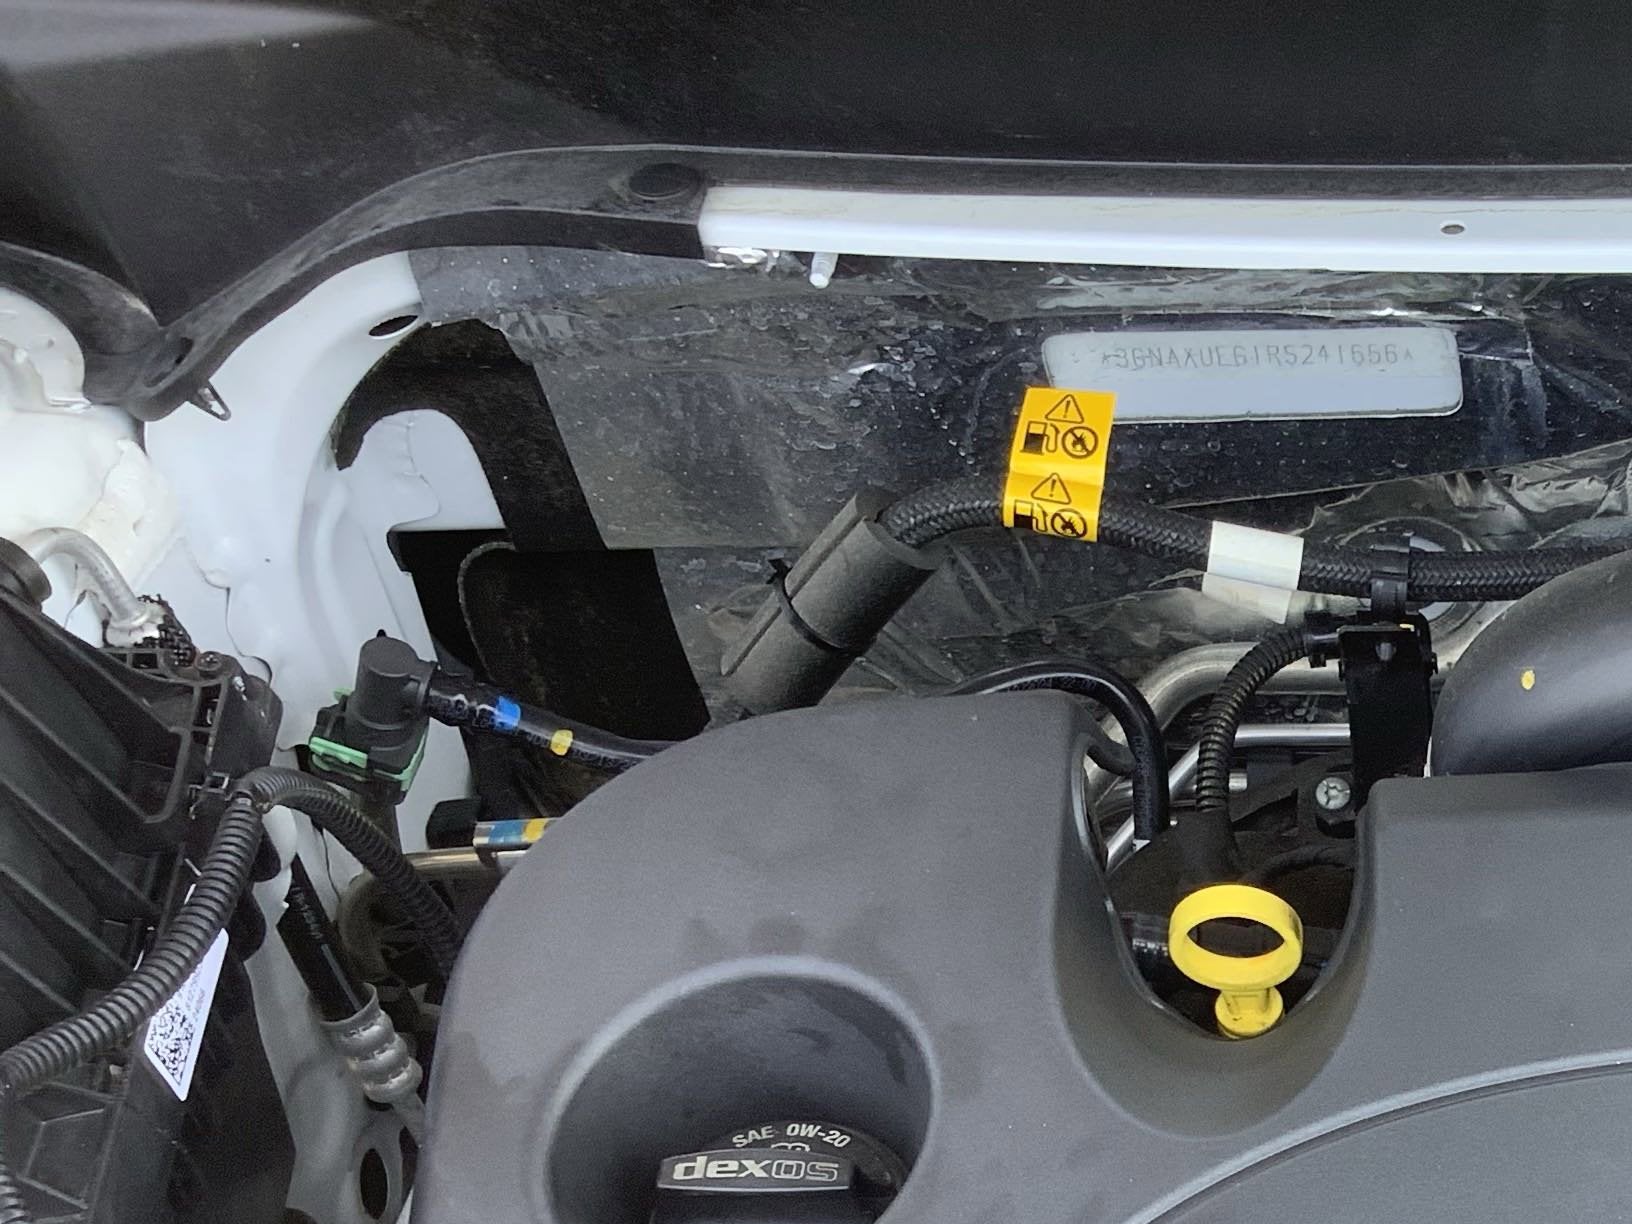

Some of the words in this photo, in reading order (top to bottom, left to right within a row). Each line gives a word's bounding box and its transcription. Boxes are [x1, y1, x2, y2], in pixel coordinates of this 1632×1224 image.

[732, 1125, 774, 1148] SAE
[786, 1123, 851, 1149] 0W-20
[673, 1156, 840, 1182] dexos
